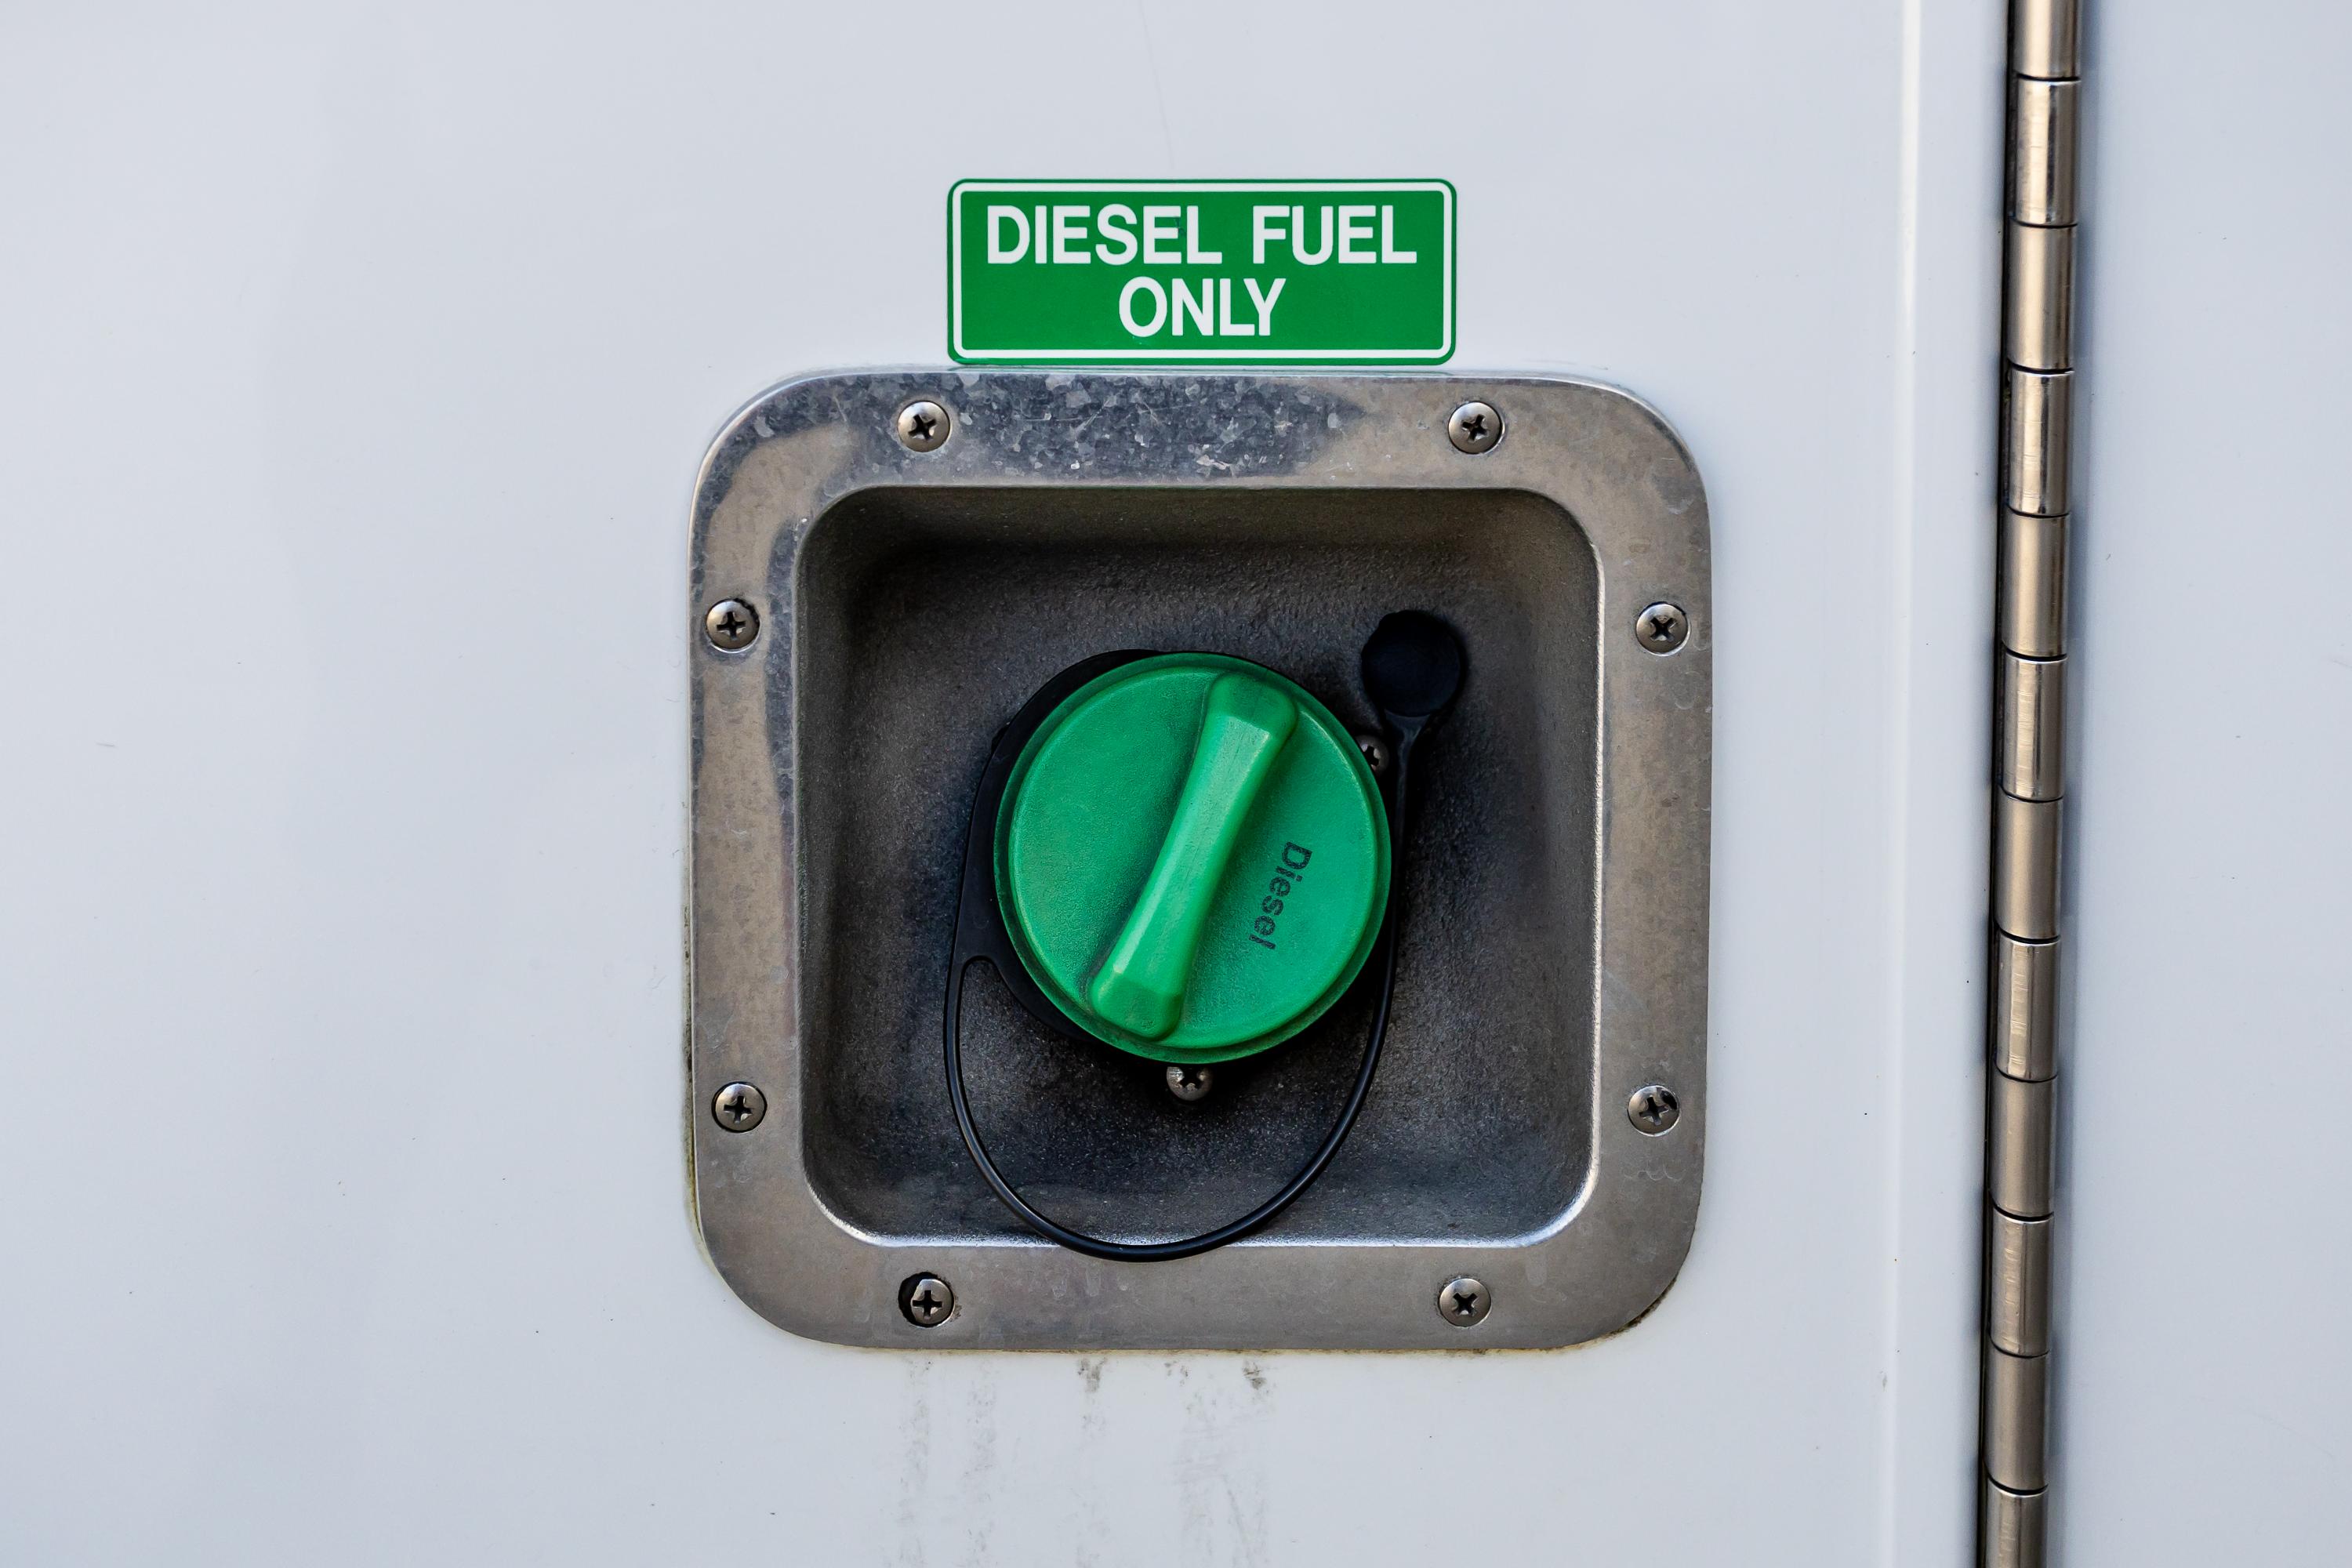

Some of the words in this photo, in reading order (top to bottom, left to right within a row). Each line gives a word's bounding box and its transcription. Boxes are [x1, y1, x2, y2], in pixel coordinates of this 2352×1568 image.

[987, 204, 1222, 265] DIESEL
[1253, 205, 1417, 265] FUEL
[1119, 276, 1286, 337] ONLY
[1248, 841, 1313, 950] Diesel
